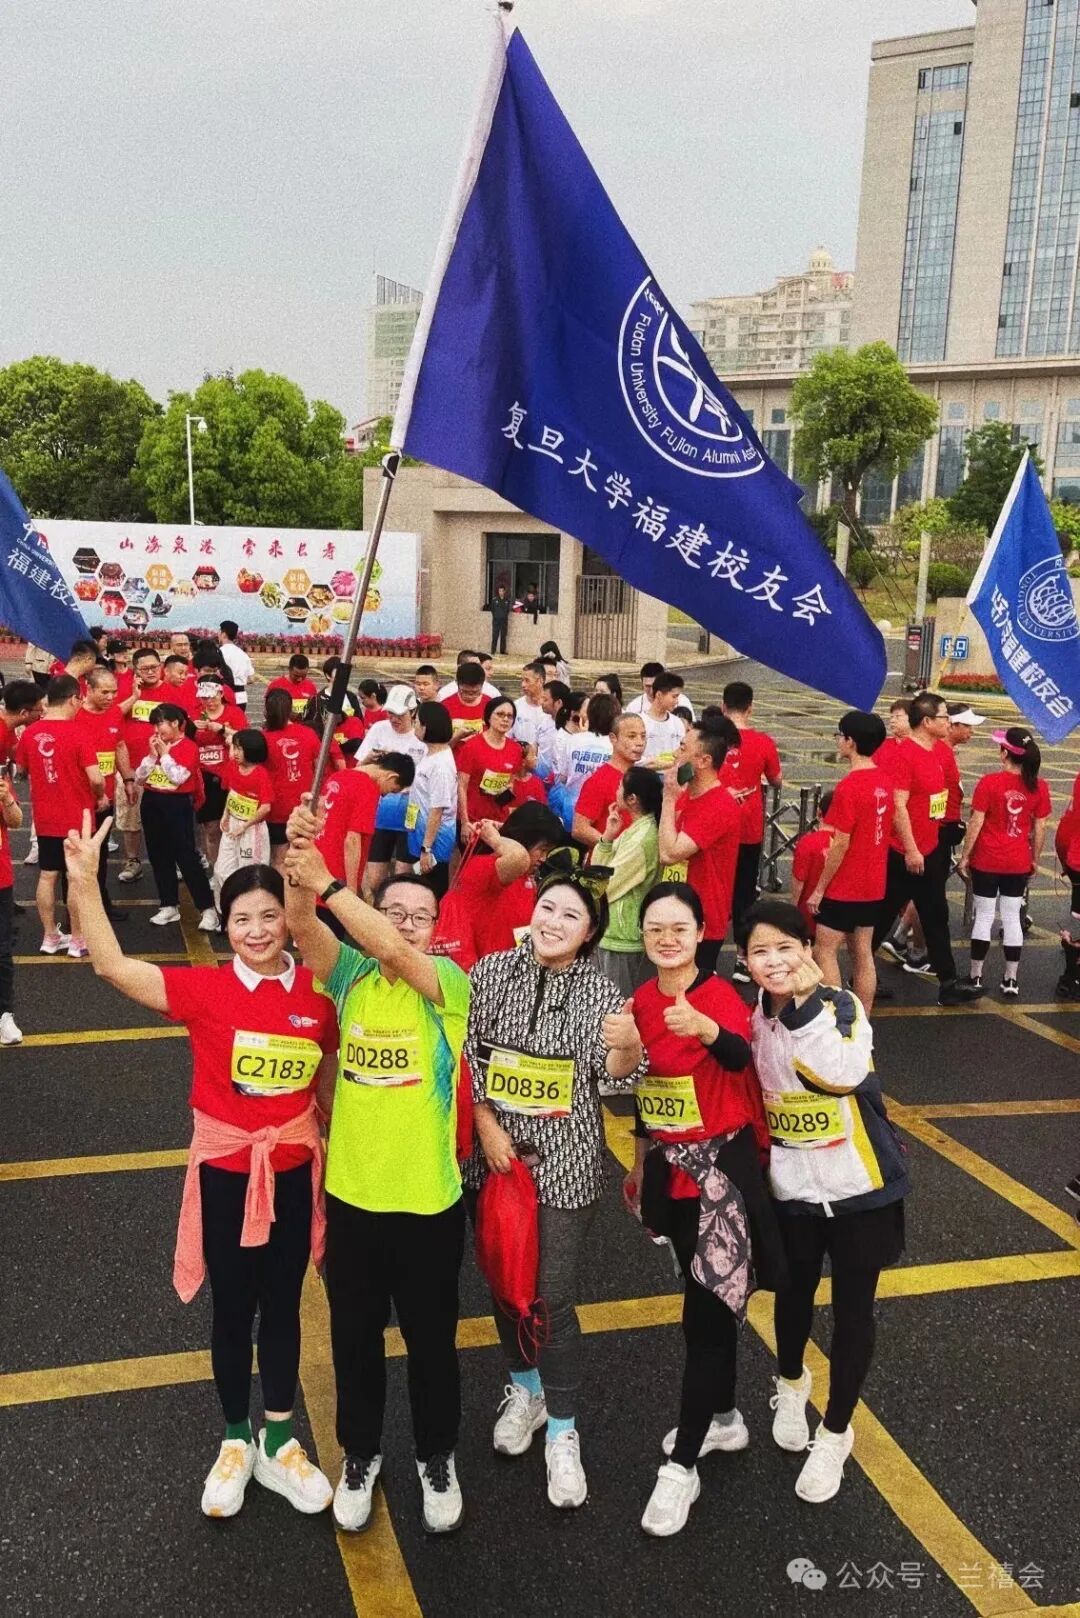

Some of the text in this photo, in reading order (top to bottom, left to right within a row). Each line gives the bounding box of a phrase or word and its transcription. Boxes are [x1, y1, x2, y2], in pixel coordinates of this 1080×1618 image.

[630, 313, 652, 356] Fudan
[630, 362, 662, 429] University
[660, 426, 699, 458] Fujian
[702, 448, 741, 464] Alumni
[501, 401, 832, 626] 复旦大学福建校友会
[236, 1055, 306, 1080] C2183
[346, 1043, 409, 1069] D0288
[491, 1073, 560, 1100] D0836
[768, 1112, 830, 1133] D0289
